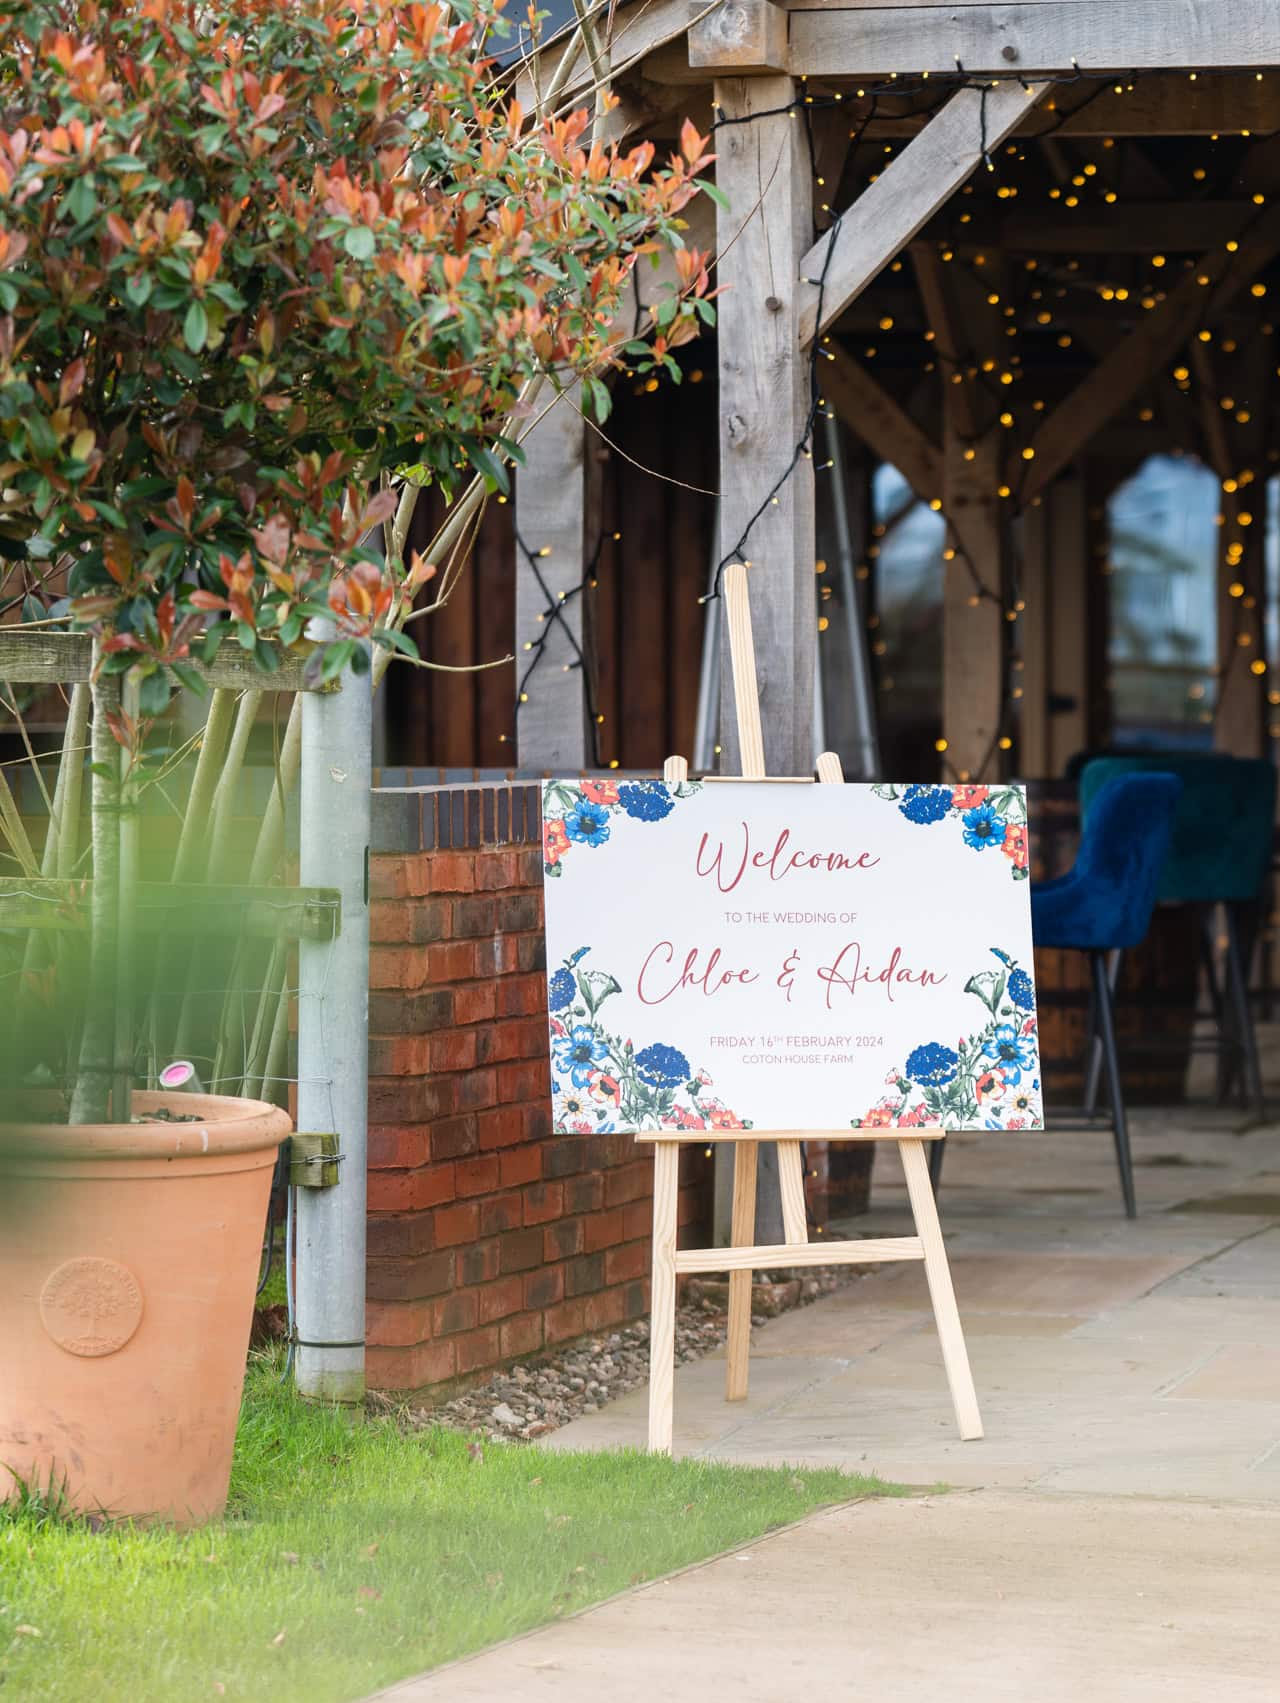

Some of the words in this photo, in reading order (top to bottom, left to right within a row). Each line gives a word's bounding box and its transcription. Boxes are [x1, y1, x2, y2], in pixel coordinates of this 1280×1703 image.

[696, 821, 881, 893] Welcome
[724, 912, 742, 924] TO
[746, 912, 769, 924] THE
[773, 912, 837, 924] WEDDING
[840, 912, 858, 924] OF
[637, 941, 760, 1006] Chloe
[777, 948, 801, 1003] &
[816, 941, 949, 1010] Aidan
[709, 1036, 756, 1048] FRIDAY
[786, 1036, 853, 1048] FEBRUARY
[855, 1036, 884, 1048] 2024
[742, 1054, 782, 1064] COTON
[785, 1054, 821, 1064] HOUSE
[824, 1054, 854, 1064] FARM
